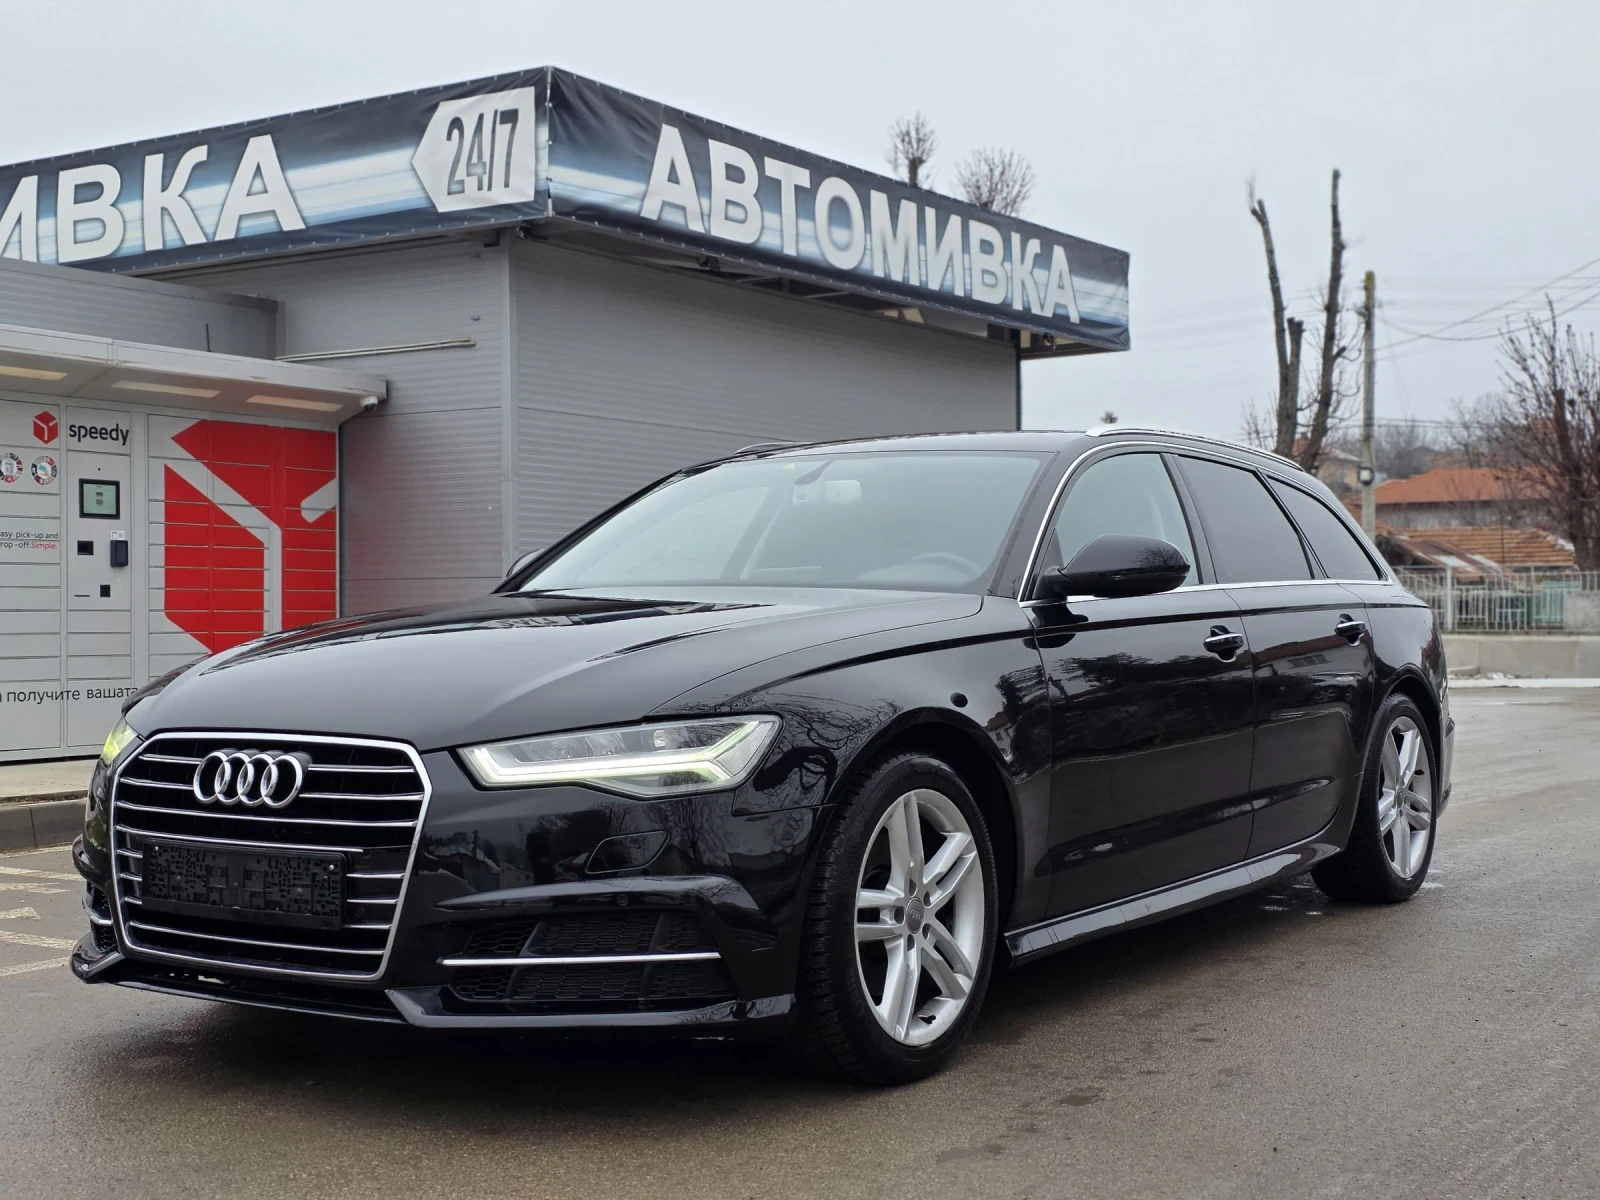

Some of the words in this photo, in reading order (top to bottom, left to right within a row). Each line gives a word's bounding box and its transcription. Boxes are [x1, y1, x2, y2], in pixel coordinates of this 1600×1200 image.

[446, 108, 520, 197] 24/7
[639, 123, 1081, 325] АВТОМИВКА
[68, 423, 130, 446] speedy
[16, 530, 44, 540] pick-up
[45, 532, 59, 540] and
[7, 689, 81, 705] получите
